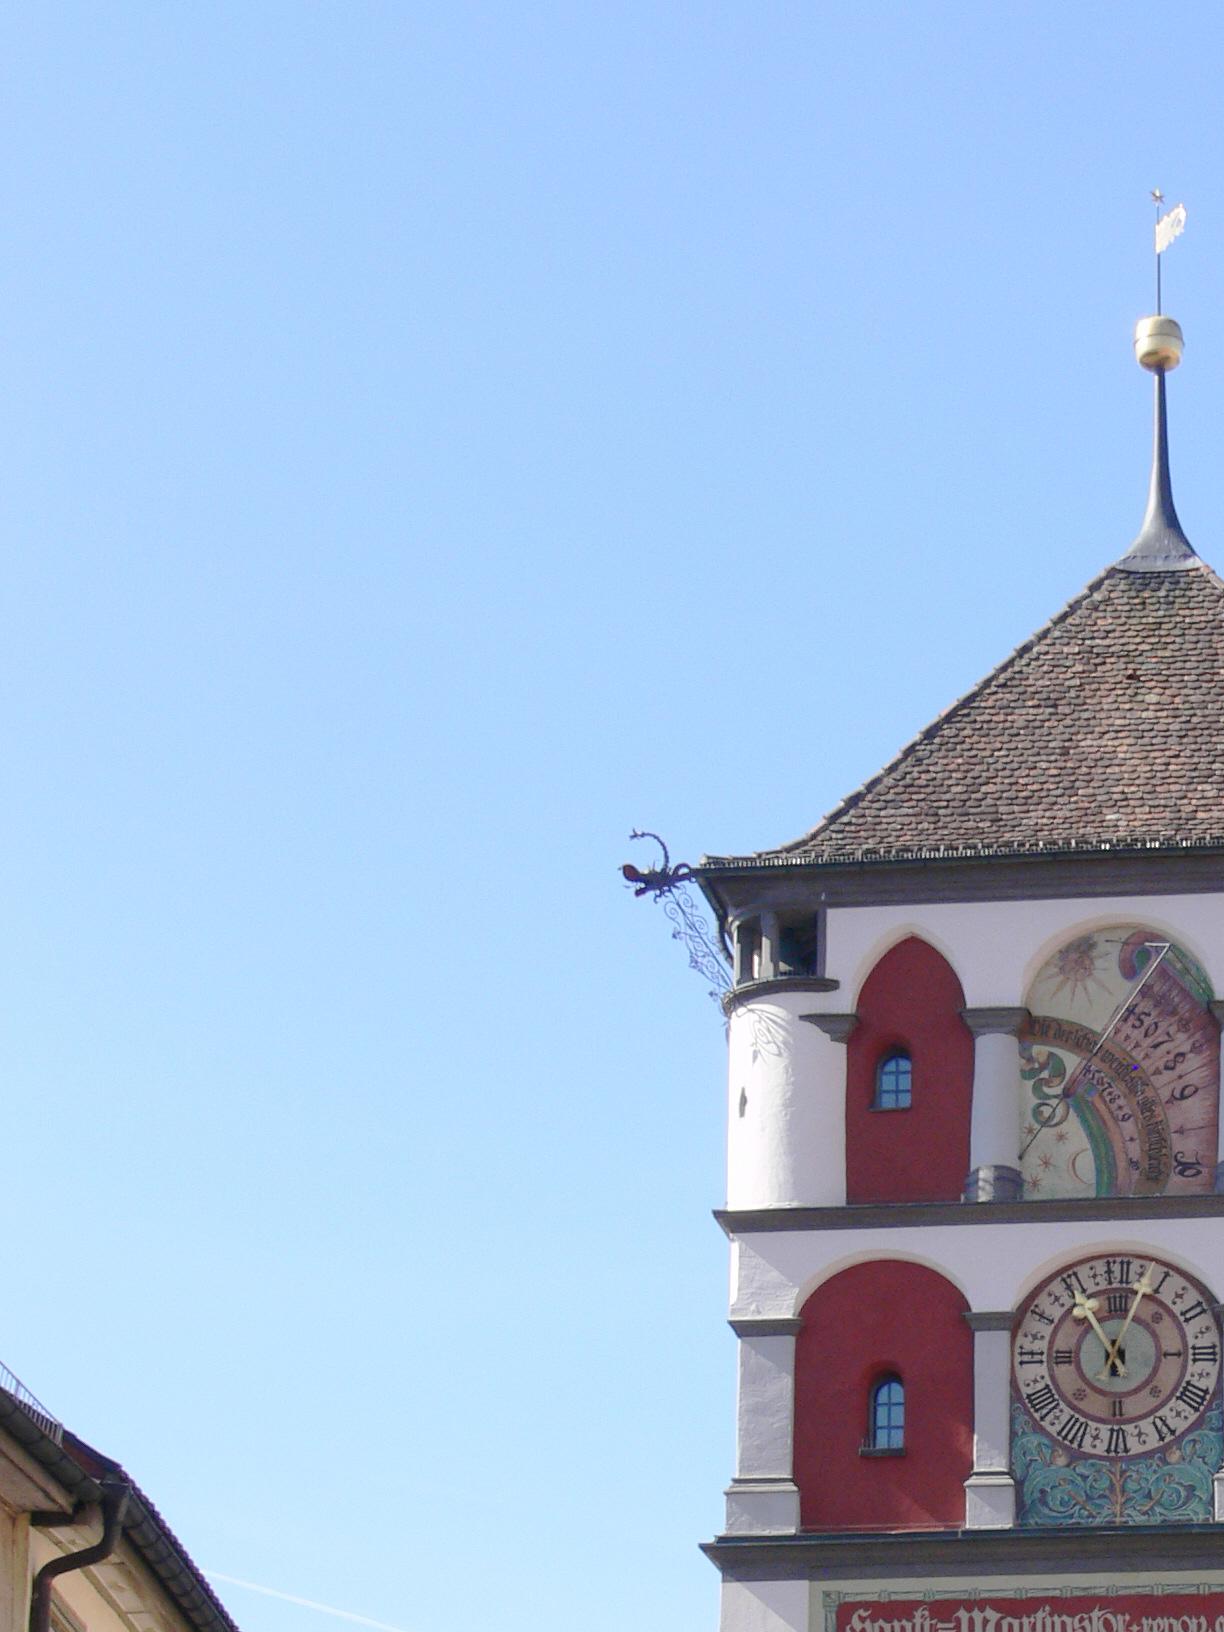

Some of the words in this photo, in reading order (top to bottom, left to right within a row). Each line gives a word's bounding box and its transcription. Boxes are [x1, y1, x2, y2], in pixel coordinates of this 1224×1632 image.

[1164, 1052, 1186, 1070] 8
[1180, 1301, 1207, 1323] II
[1190, 1343, 1218, 1363] III
